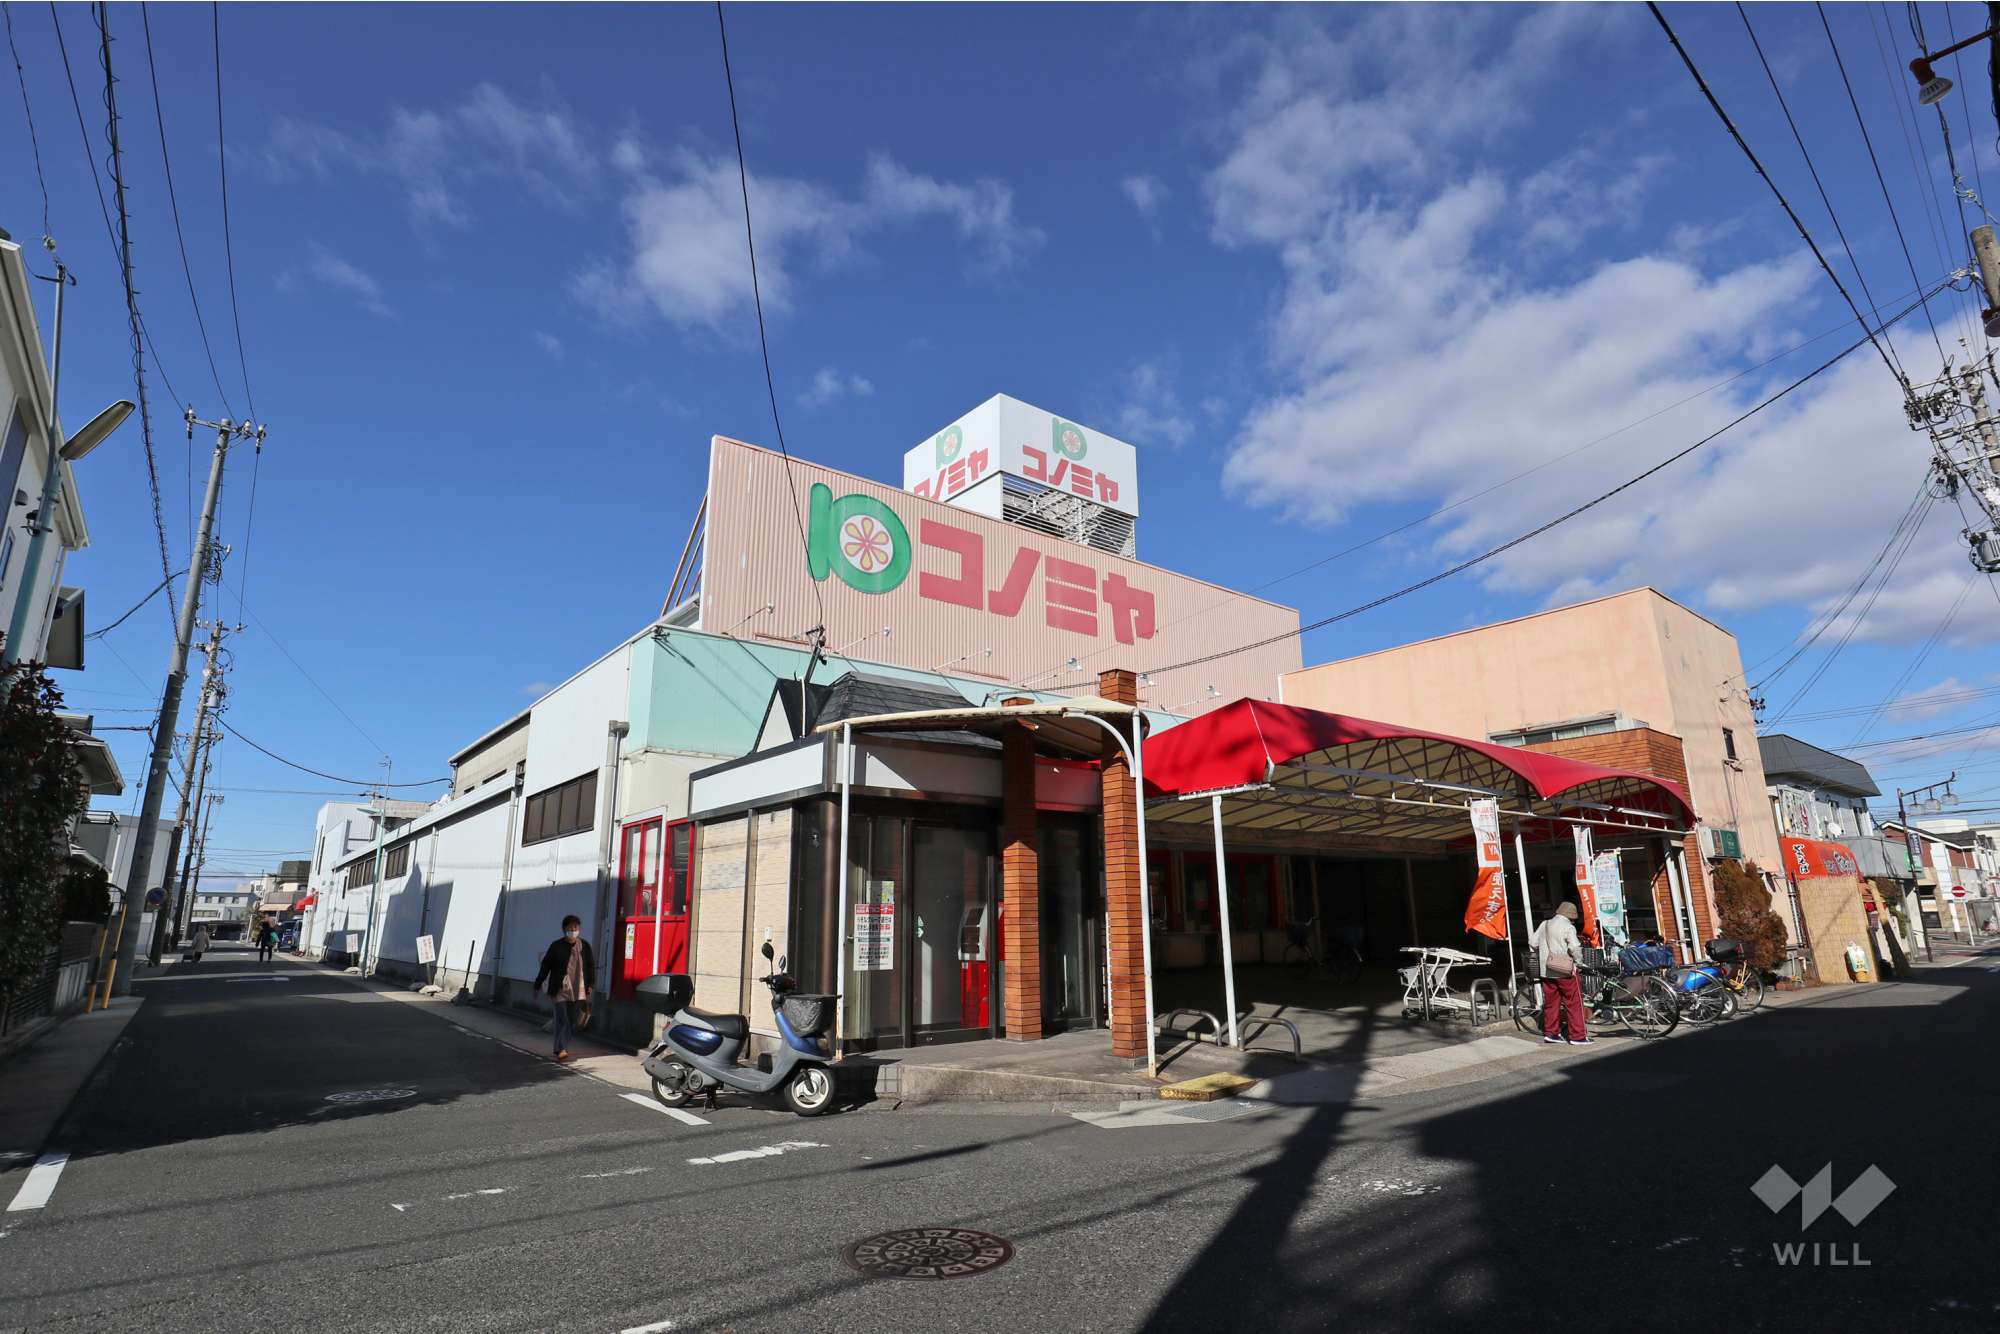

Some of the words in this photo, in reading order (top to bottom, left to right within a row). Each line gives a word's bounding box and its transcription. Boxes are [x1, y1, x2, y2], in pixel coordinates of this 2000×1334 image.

[1023, 444, 1119, 503] コノミヤ
[919, 518, 1157, 645] コノミヤ
